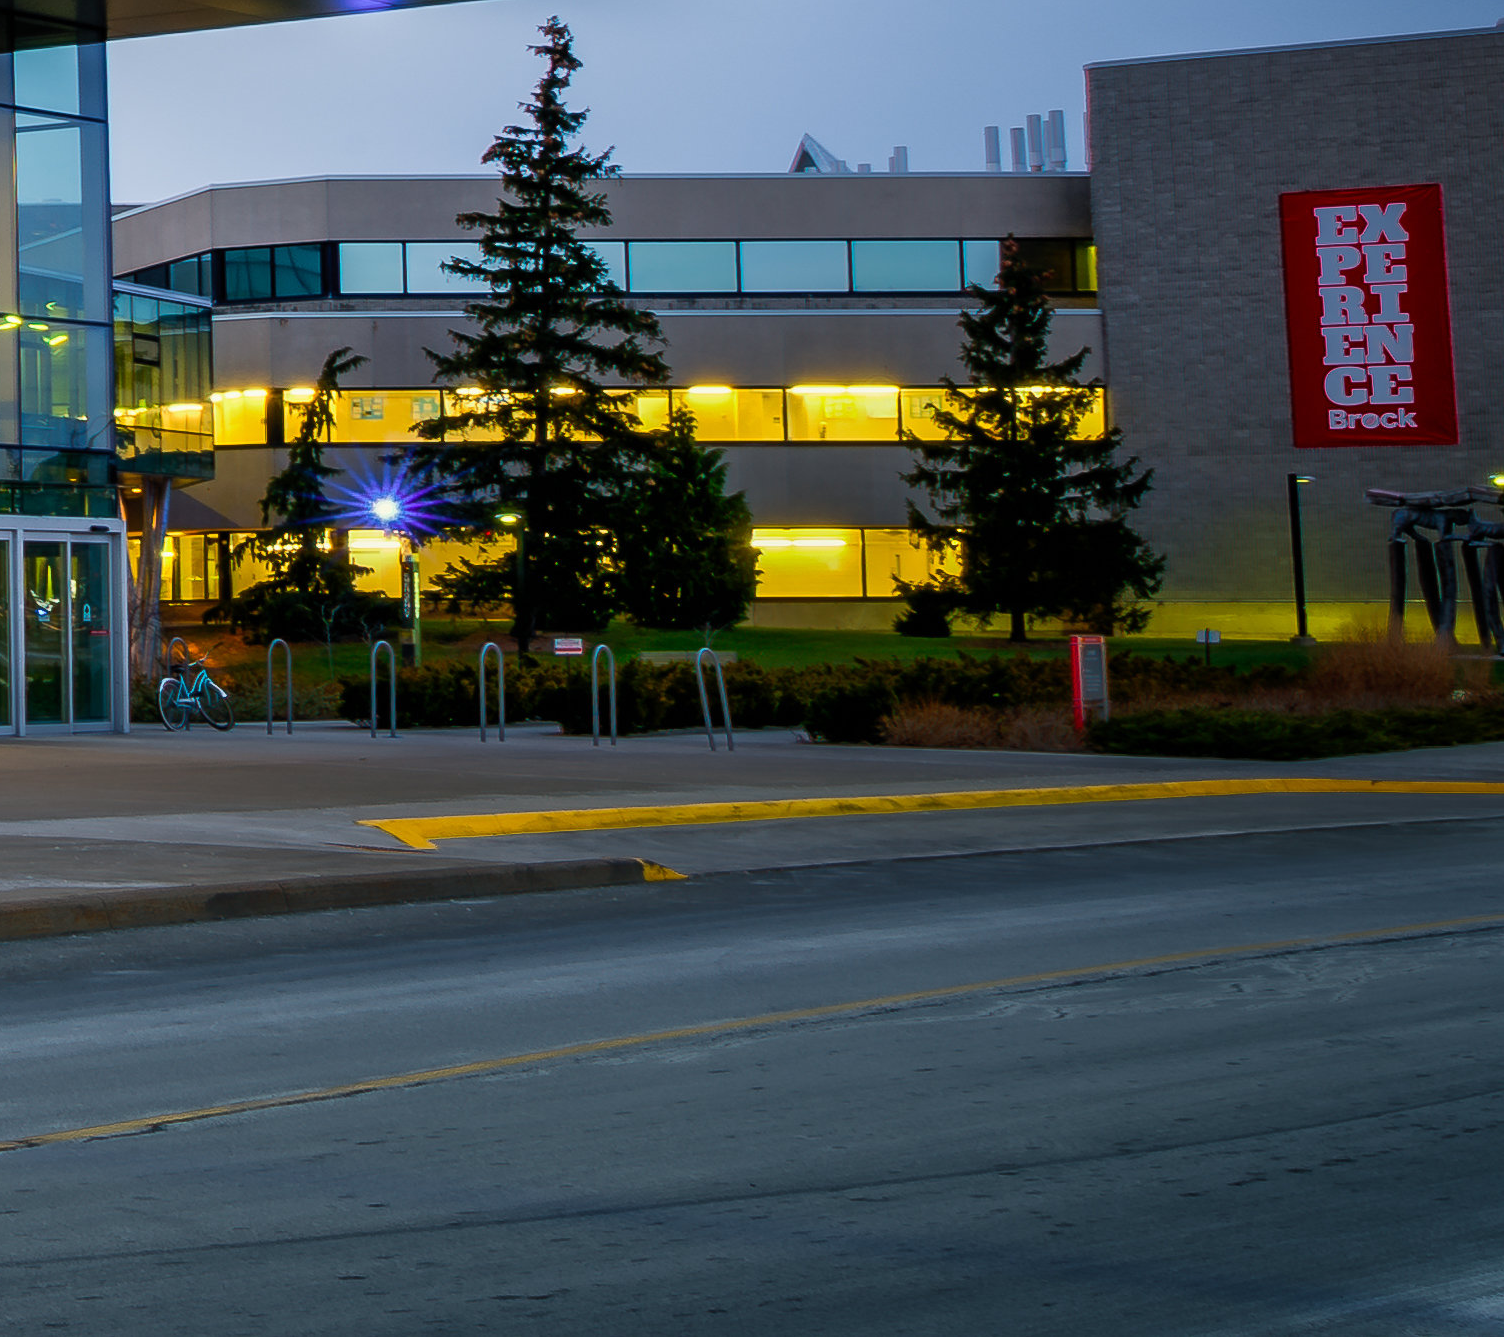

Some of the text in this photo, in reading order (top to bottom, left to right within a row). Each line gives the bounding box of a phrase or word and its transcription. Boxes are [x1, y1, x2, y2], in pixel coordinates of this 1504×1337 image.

[1313, 202, 1409, 246] EX
[1316, 243, 1408, 286] PE
[1318, 283, 1410, 326] RI
[1321, 323, 1415, 366] EN
[1323, 364, 1415, 406] CE
[1328, 408, 1418, 430] Brock
